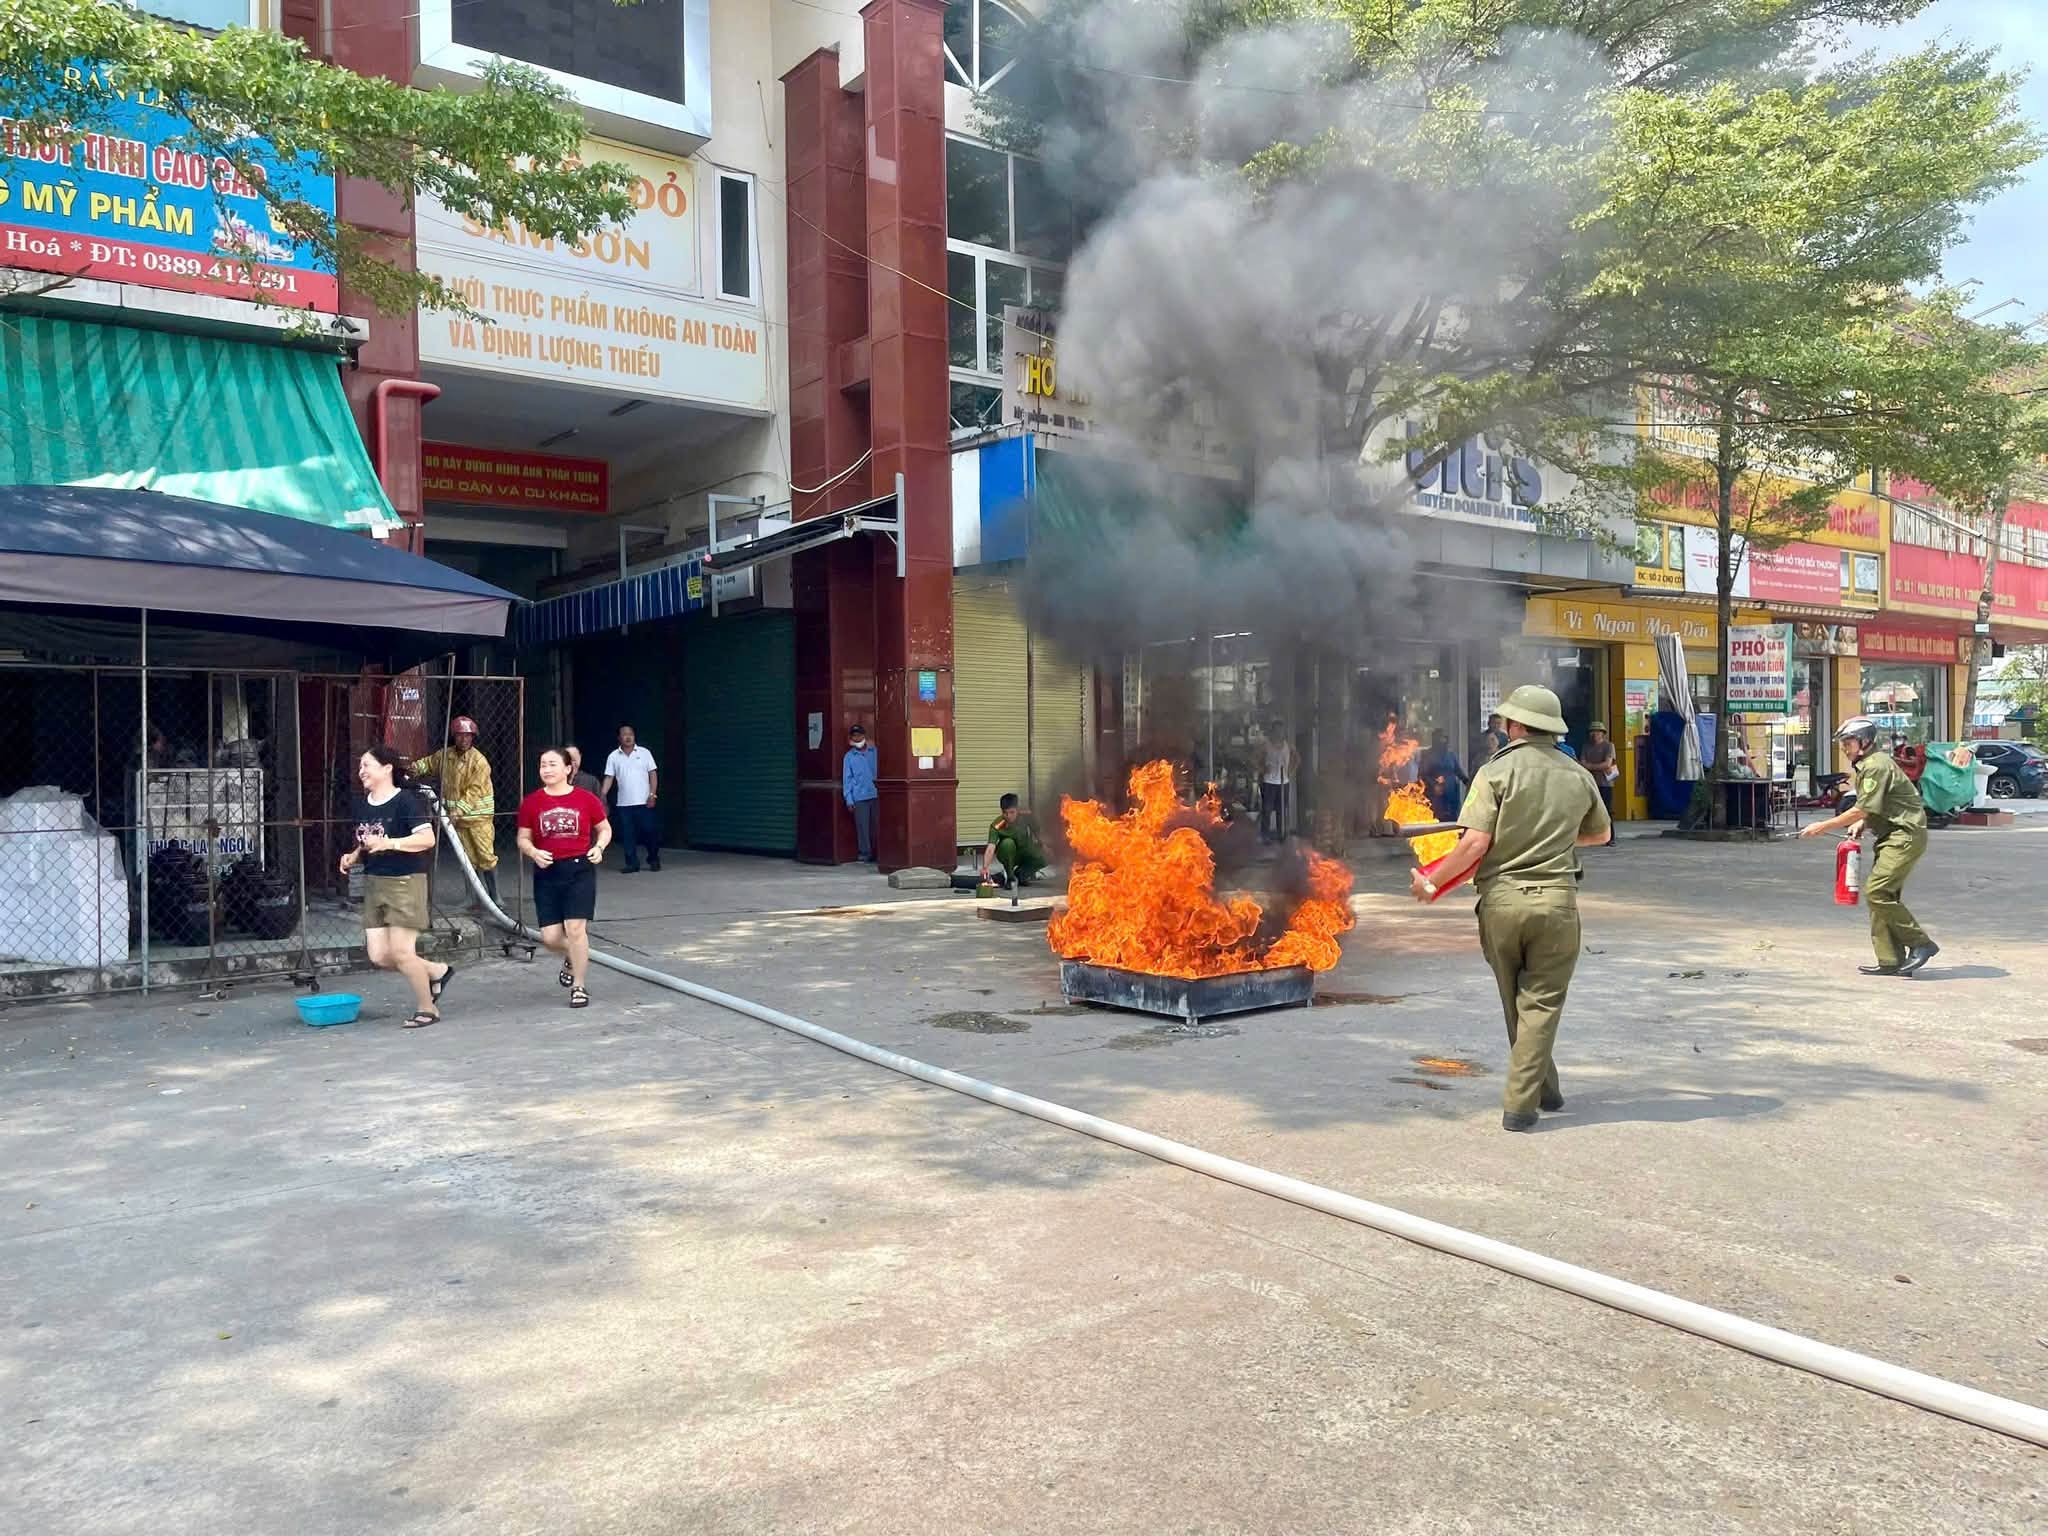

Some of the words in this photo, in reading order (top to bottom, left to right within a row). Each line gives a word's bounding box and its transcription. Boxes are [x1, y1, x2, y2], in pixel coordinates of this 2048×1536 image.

[84, 132, 147, 180] TINH
[152, 145, 209, 190] CAO
[22, 178, 79, 217] MỸ
[89, 185, 194, 236] PHẨM
[5, 229, 63, 257] Hoá
[89, 242, 137, 268] ĐT:
[491, 284, 545, 323] THỰC
[550, 289, 608, 330] PHẨM
[613, 305, 677, 342] KHÔNG
[681, 318, 707, 347] AN
[711, 321, 758, 355] TOÀN
[482, 323, 532, 361] ĐỊNH
[538, 334, 603, 371] LƯỢNG
[607, 343, 661, 378] THIẾU
[1593, 612, 1636, 638] Ngon
[1731, 634, 1766, 656] PHỞ
